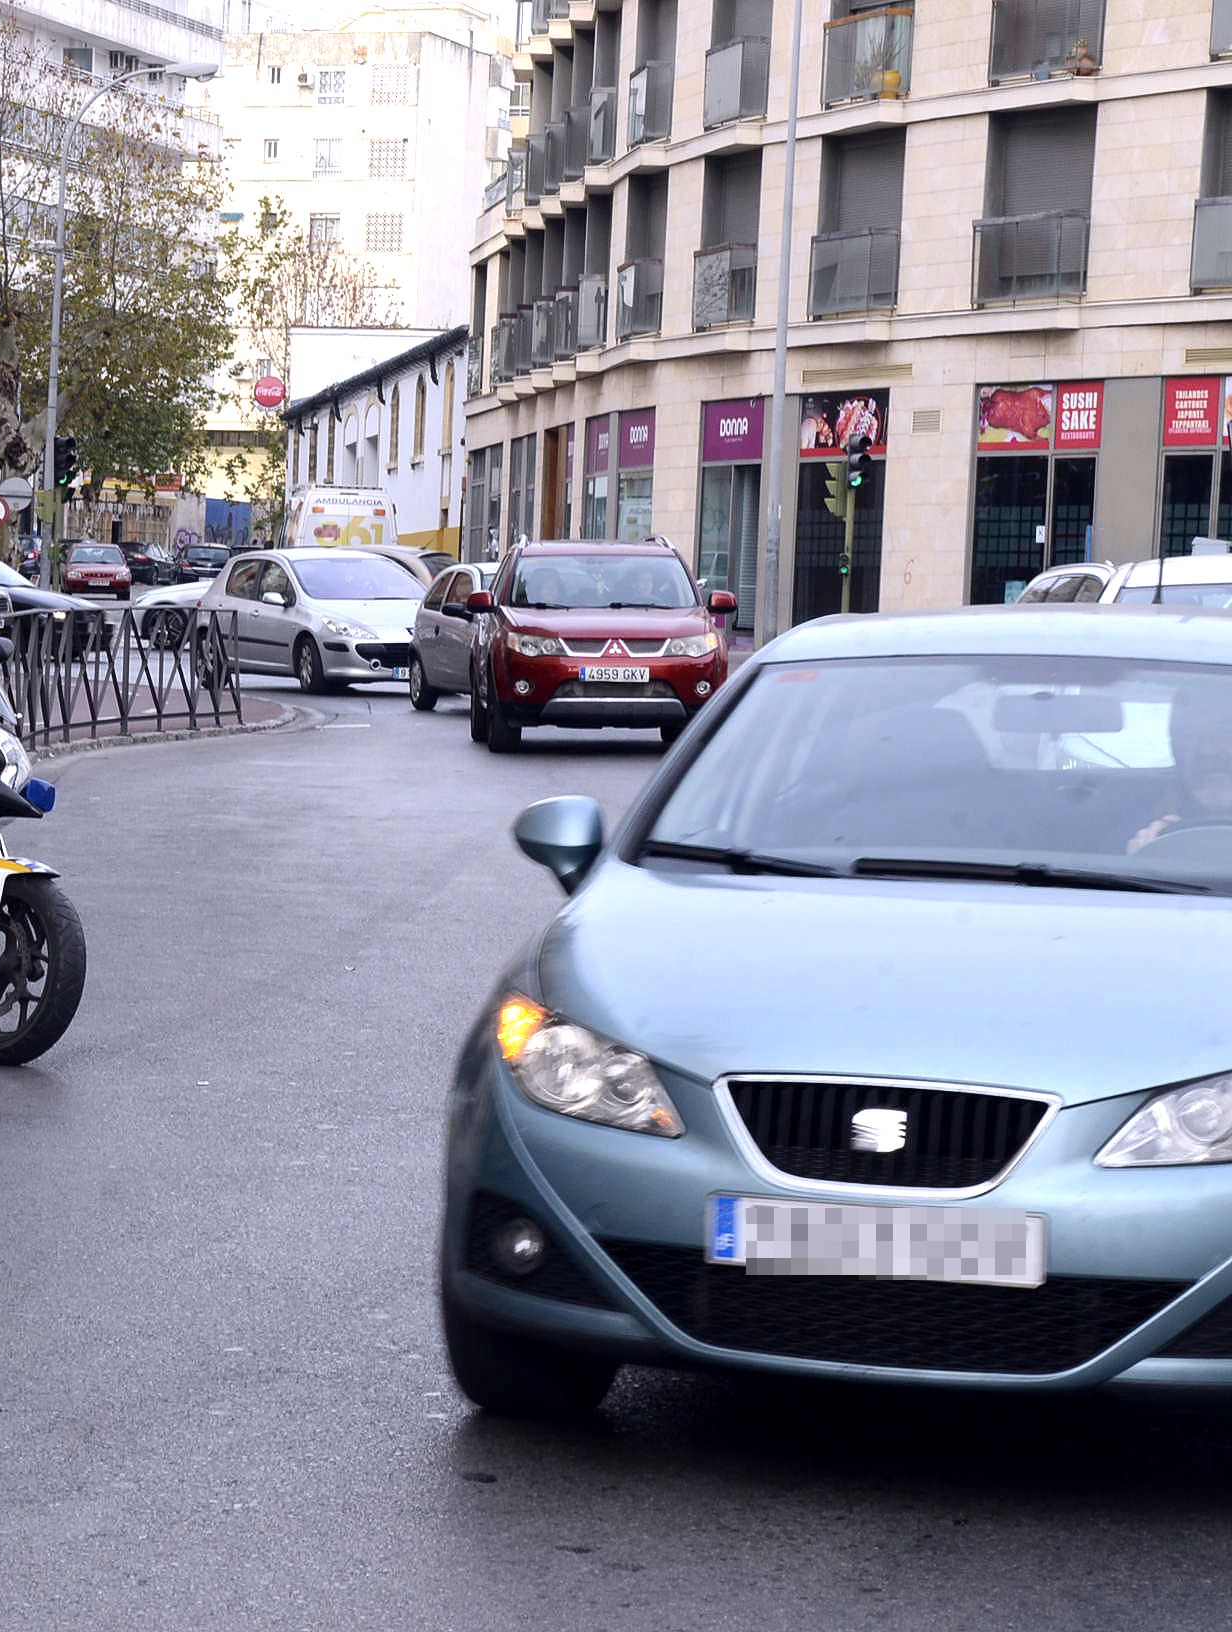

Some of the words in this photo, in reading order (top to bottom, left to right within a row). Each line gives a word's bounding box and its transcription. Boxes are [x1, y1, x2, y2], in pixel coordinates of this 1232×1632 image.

[1062, 391, 1098, 410] SUSHI
[1061, 409, 1097, 431] SAKE
[588, 667, 619, 681] 4959
[622, 667, 647, 681] GKV
